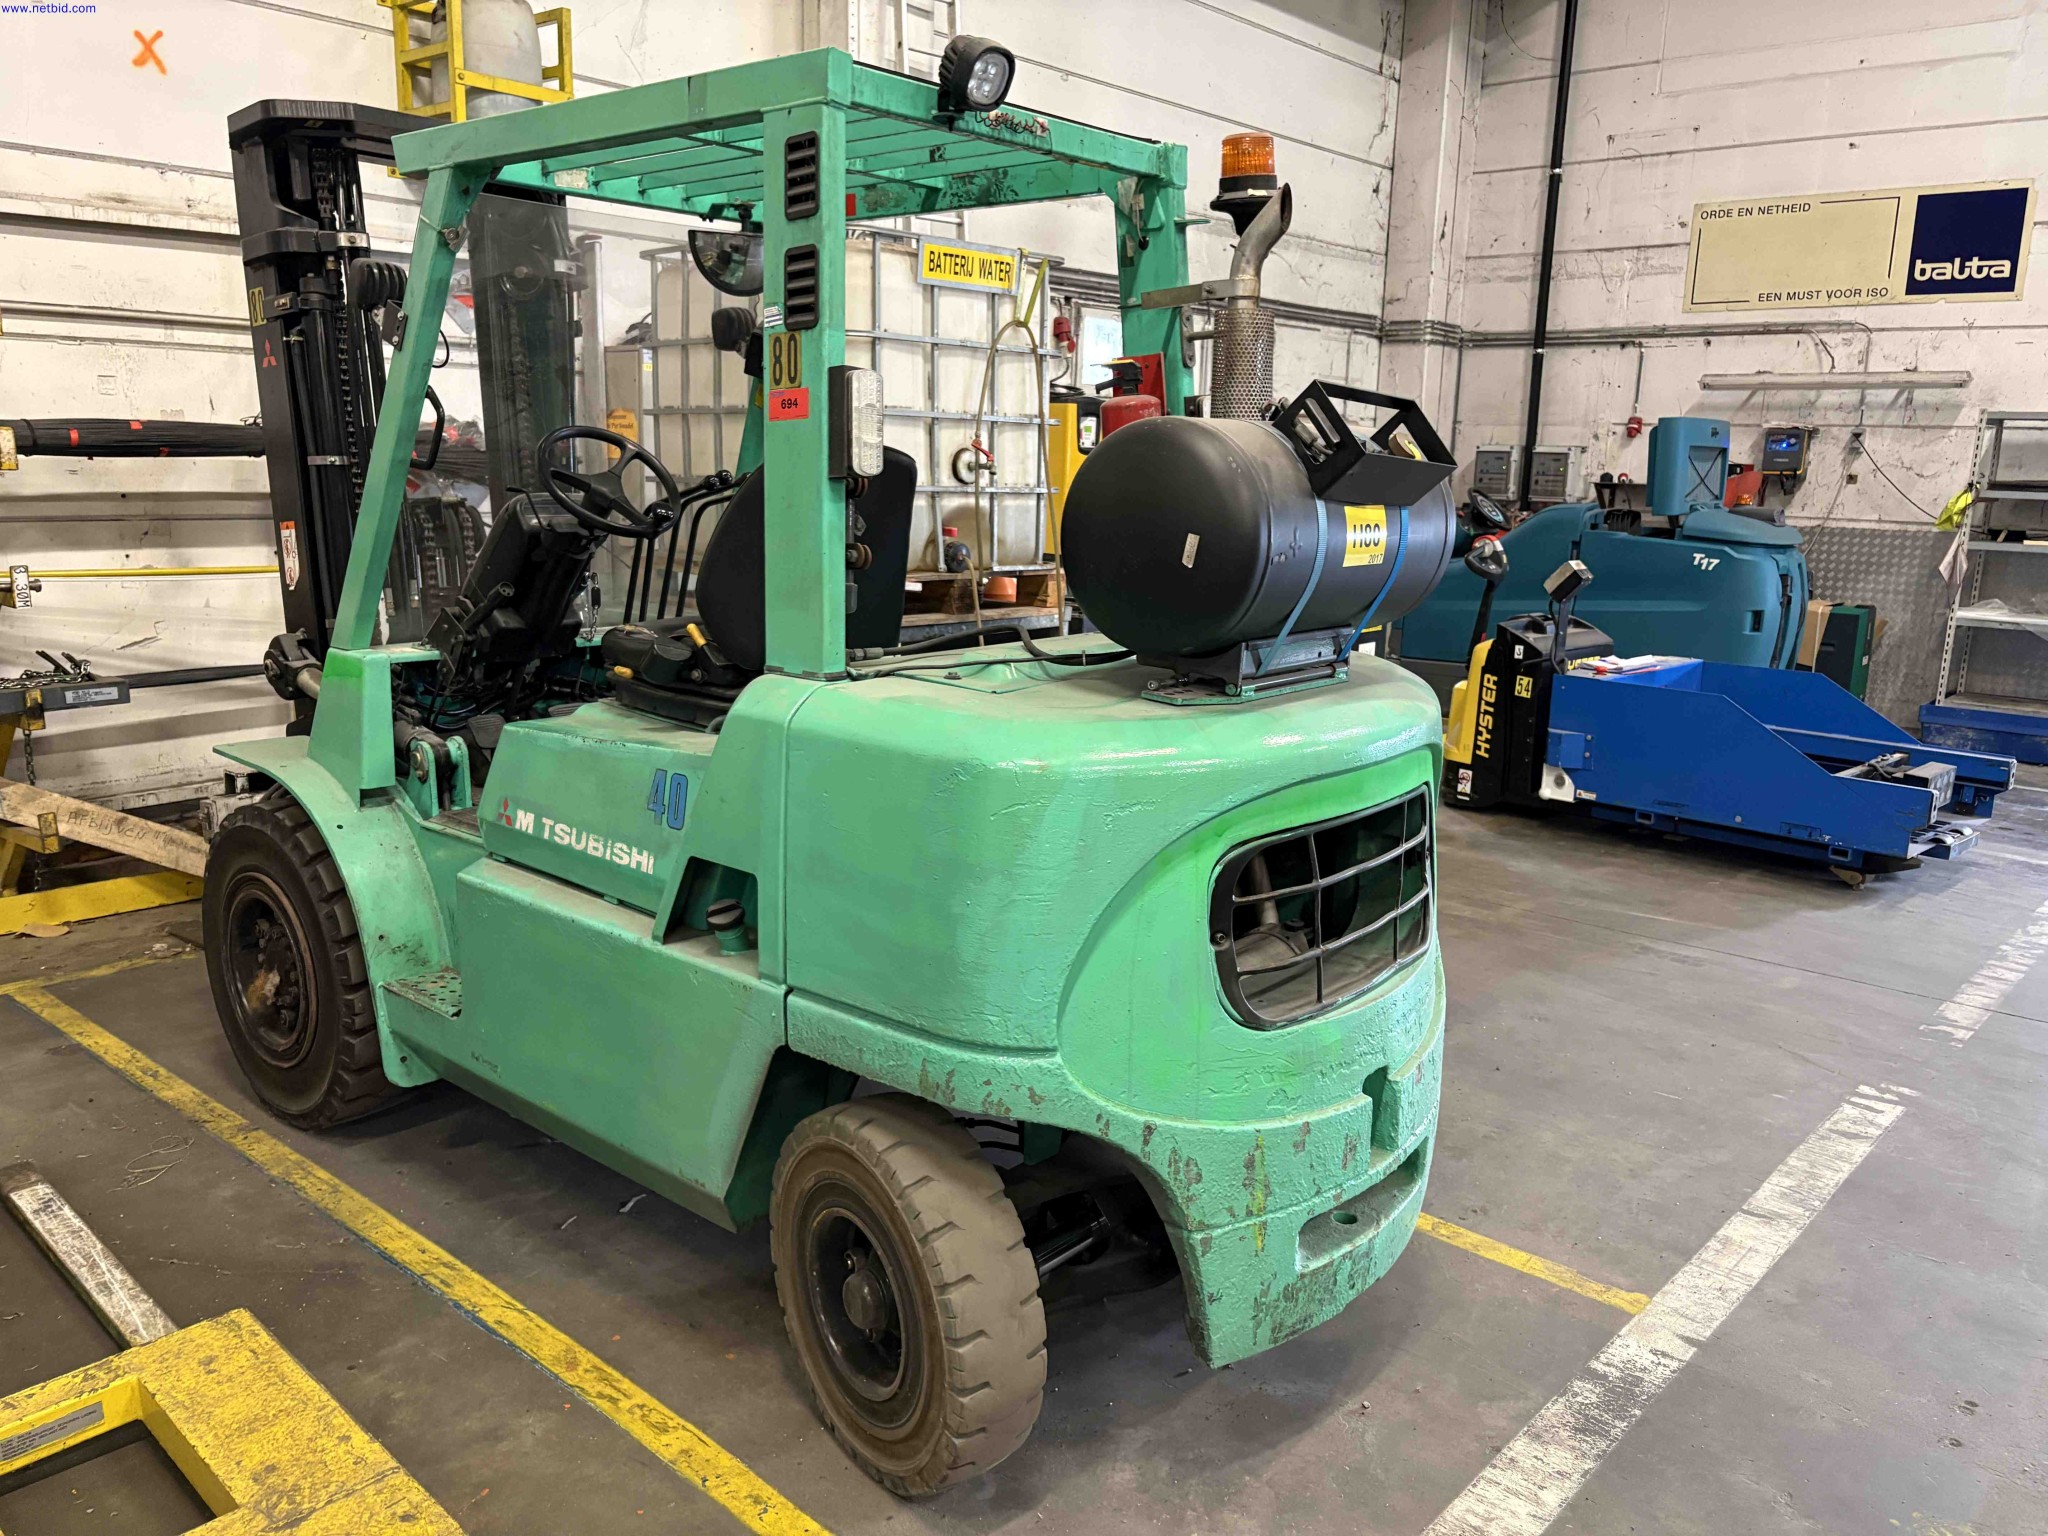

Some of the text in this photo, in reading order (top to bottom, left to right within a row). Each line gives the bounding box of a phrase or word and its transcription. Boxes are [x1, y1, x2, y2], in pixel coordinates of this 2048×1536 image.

[1700, 202, 1811, 220] ORDE EN NETHEID
[928, 250, 1011, 283] BATTERIJ WATER
[1913, 256, 2012, 281] balta
[1758, 287, 1889, 302] EEN MUST VOOR ISO
[773, 333, 798, 386] 80
[780, 398, 799, 410] 694
[1368, 553, 1383, 564] 2017
[1692, 553, 1720, 571] T17
[1517, 677, 1531, 696] 54
[1475, 673, 1498, 759] HYSTER
[647, 768, 688, 831] 40
